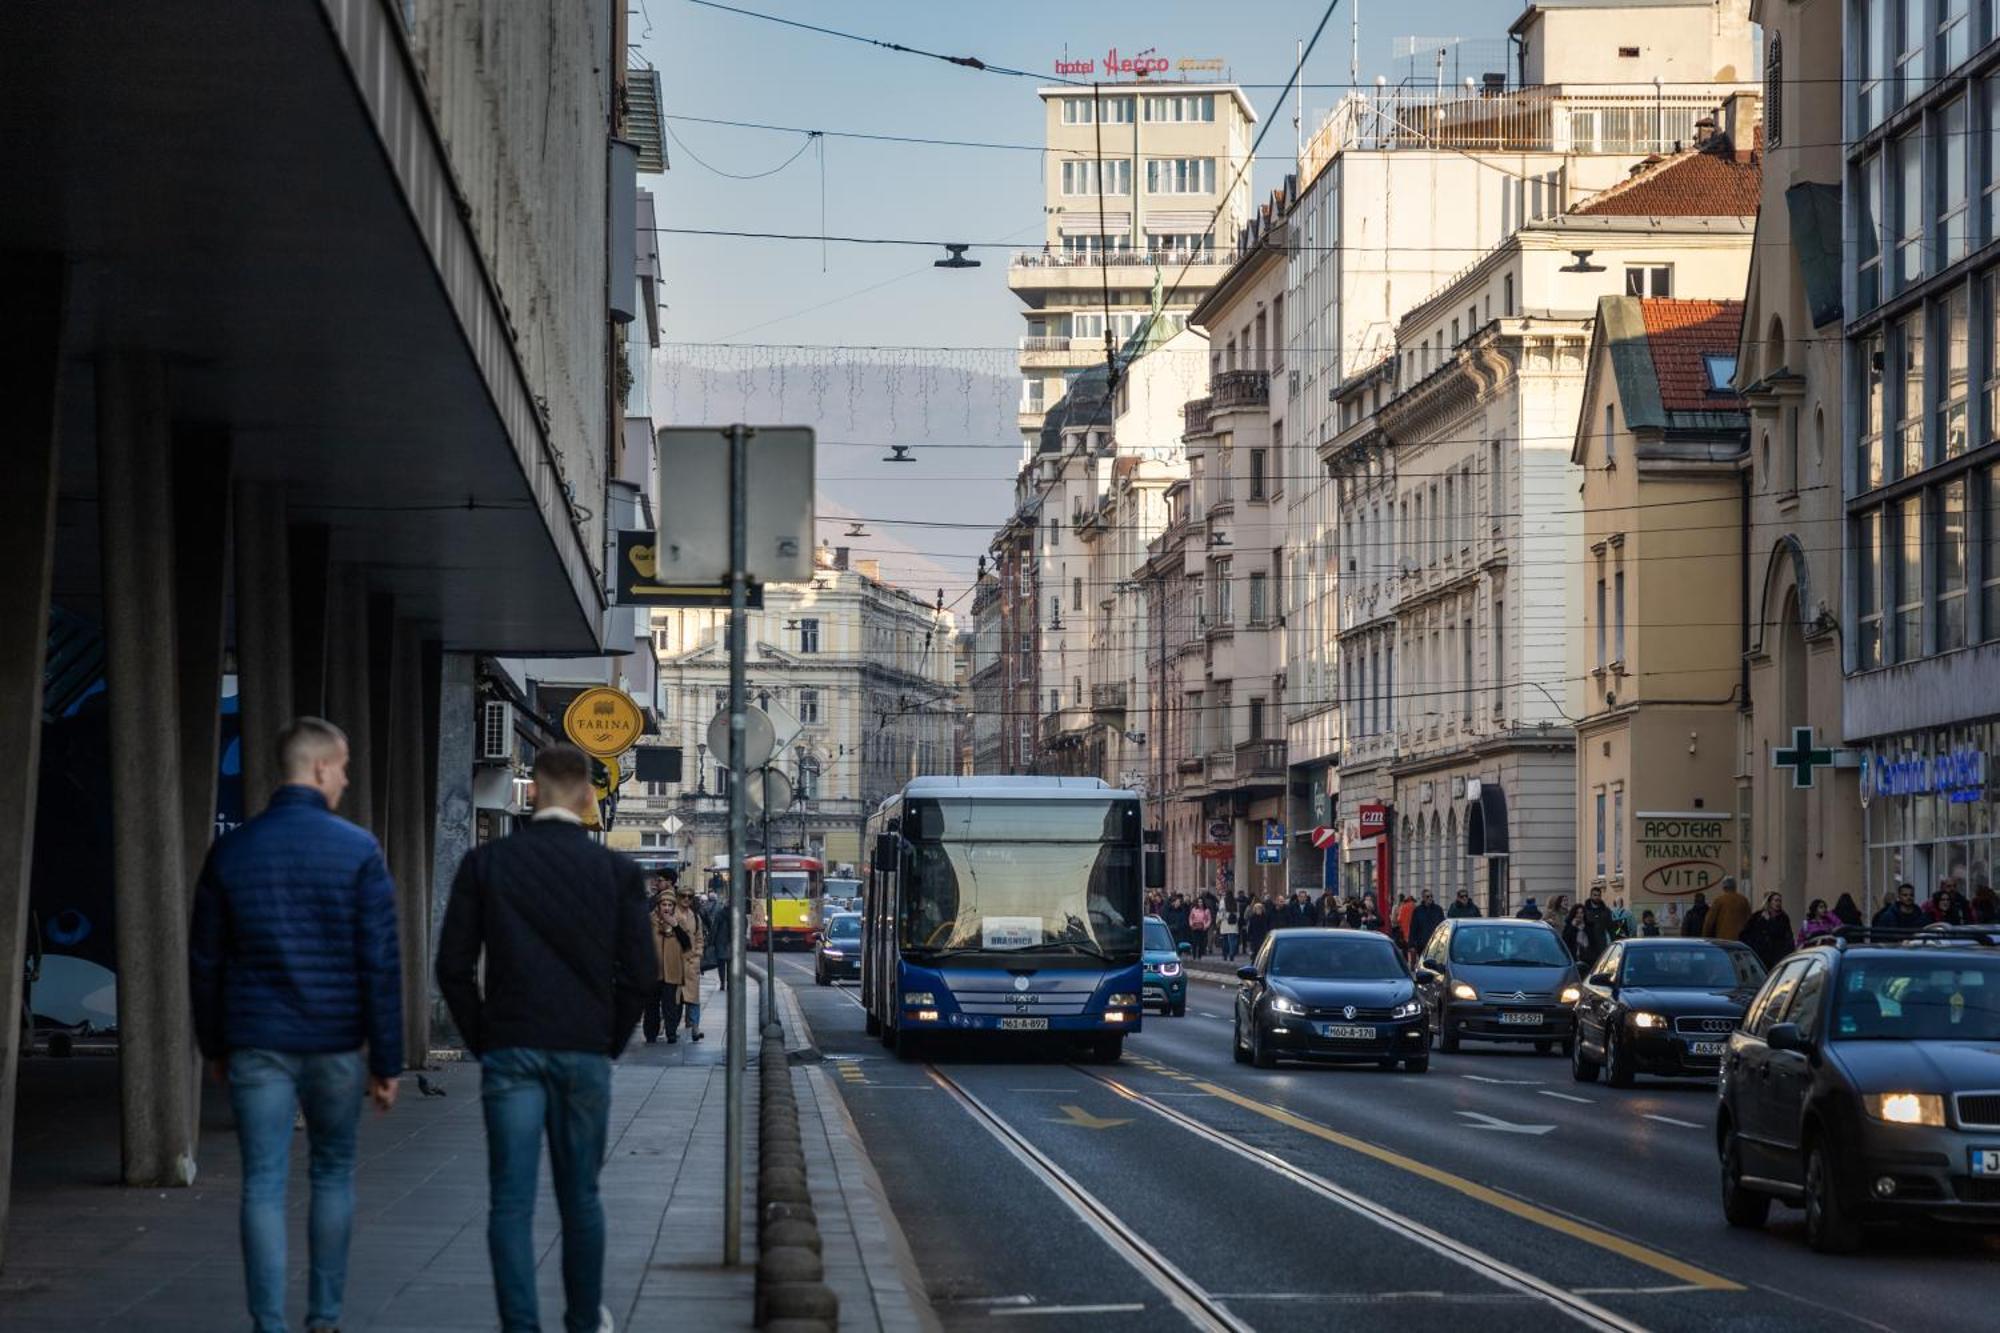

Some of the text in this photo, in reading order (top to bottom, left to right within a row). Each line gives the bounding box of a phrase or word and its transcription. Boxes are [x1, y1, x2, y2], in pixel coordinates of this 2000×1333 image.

[1055, 59, 1094, 74] hotel
[577, 719, 630, 730] FARINA
[1645, 821, 1722, 838] APOTEKA
[1645, 844, 1722, 858] PHARMACY
[1660, 870, 1709, 886] VITA
